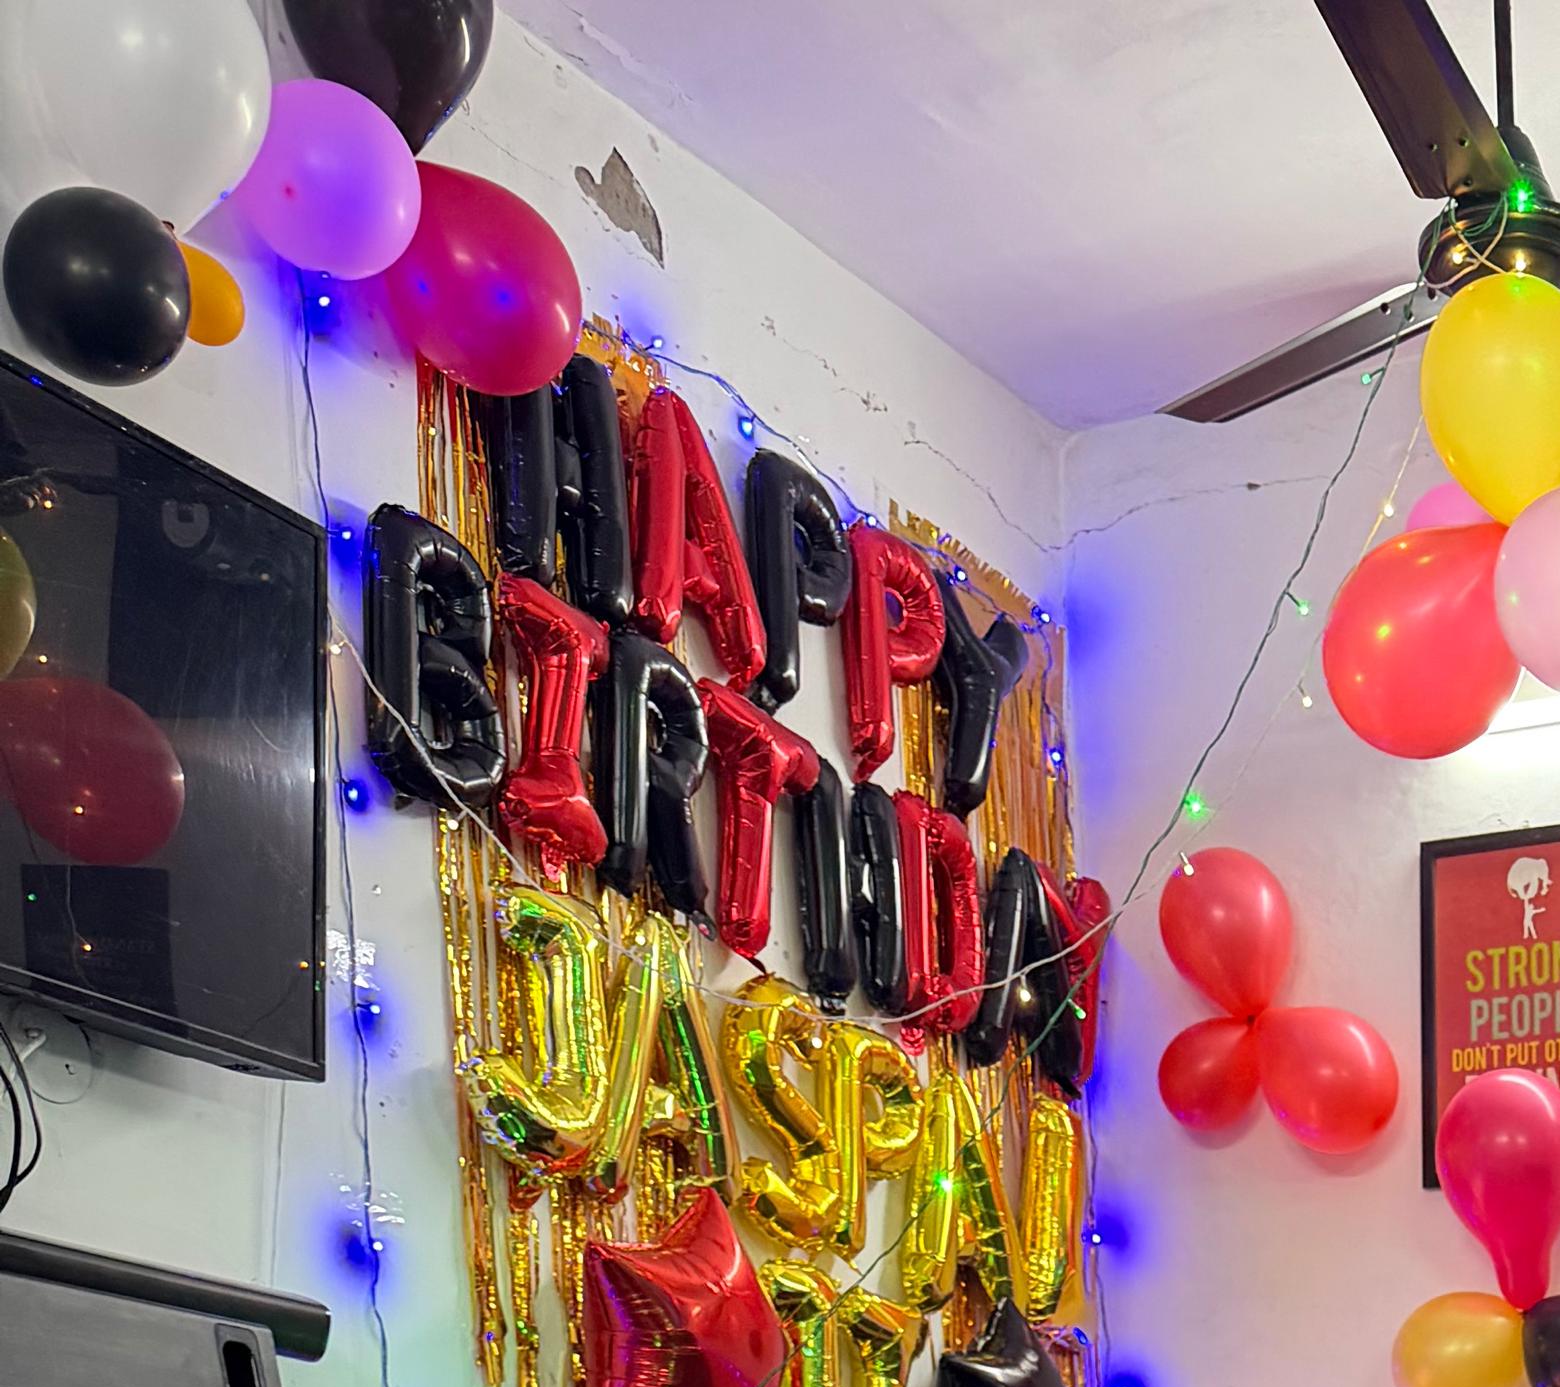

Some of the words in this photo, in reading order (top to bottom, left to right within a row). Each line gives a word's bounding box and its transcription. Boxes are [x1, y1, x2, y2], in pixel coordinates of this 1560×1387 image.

[365, 503, 1110, 1095] BIRTHDAY
[472, 354, 1029, 816] HAPPY
[1452, 1043, 1501, 1072] DON'T
[1506, 1042, 1539, 1066] PUT
